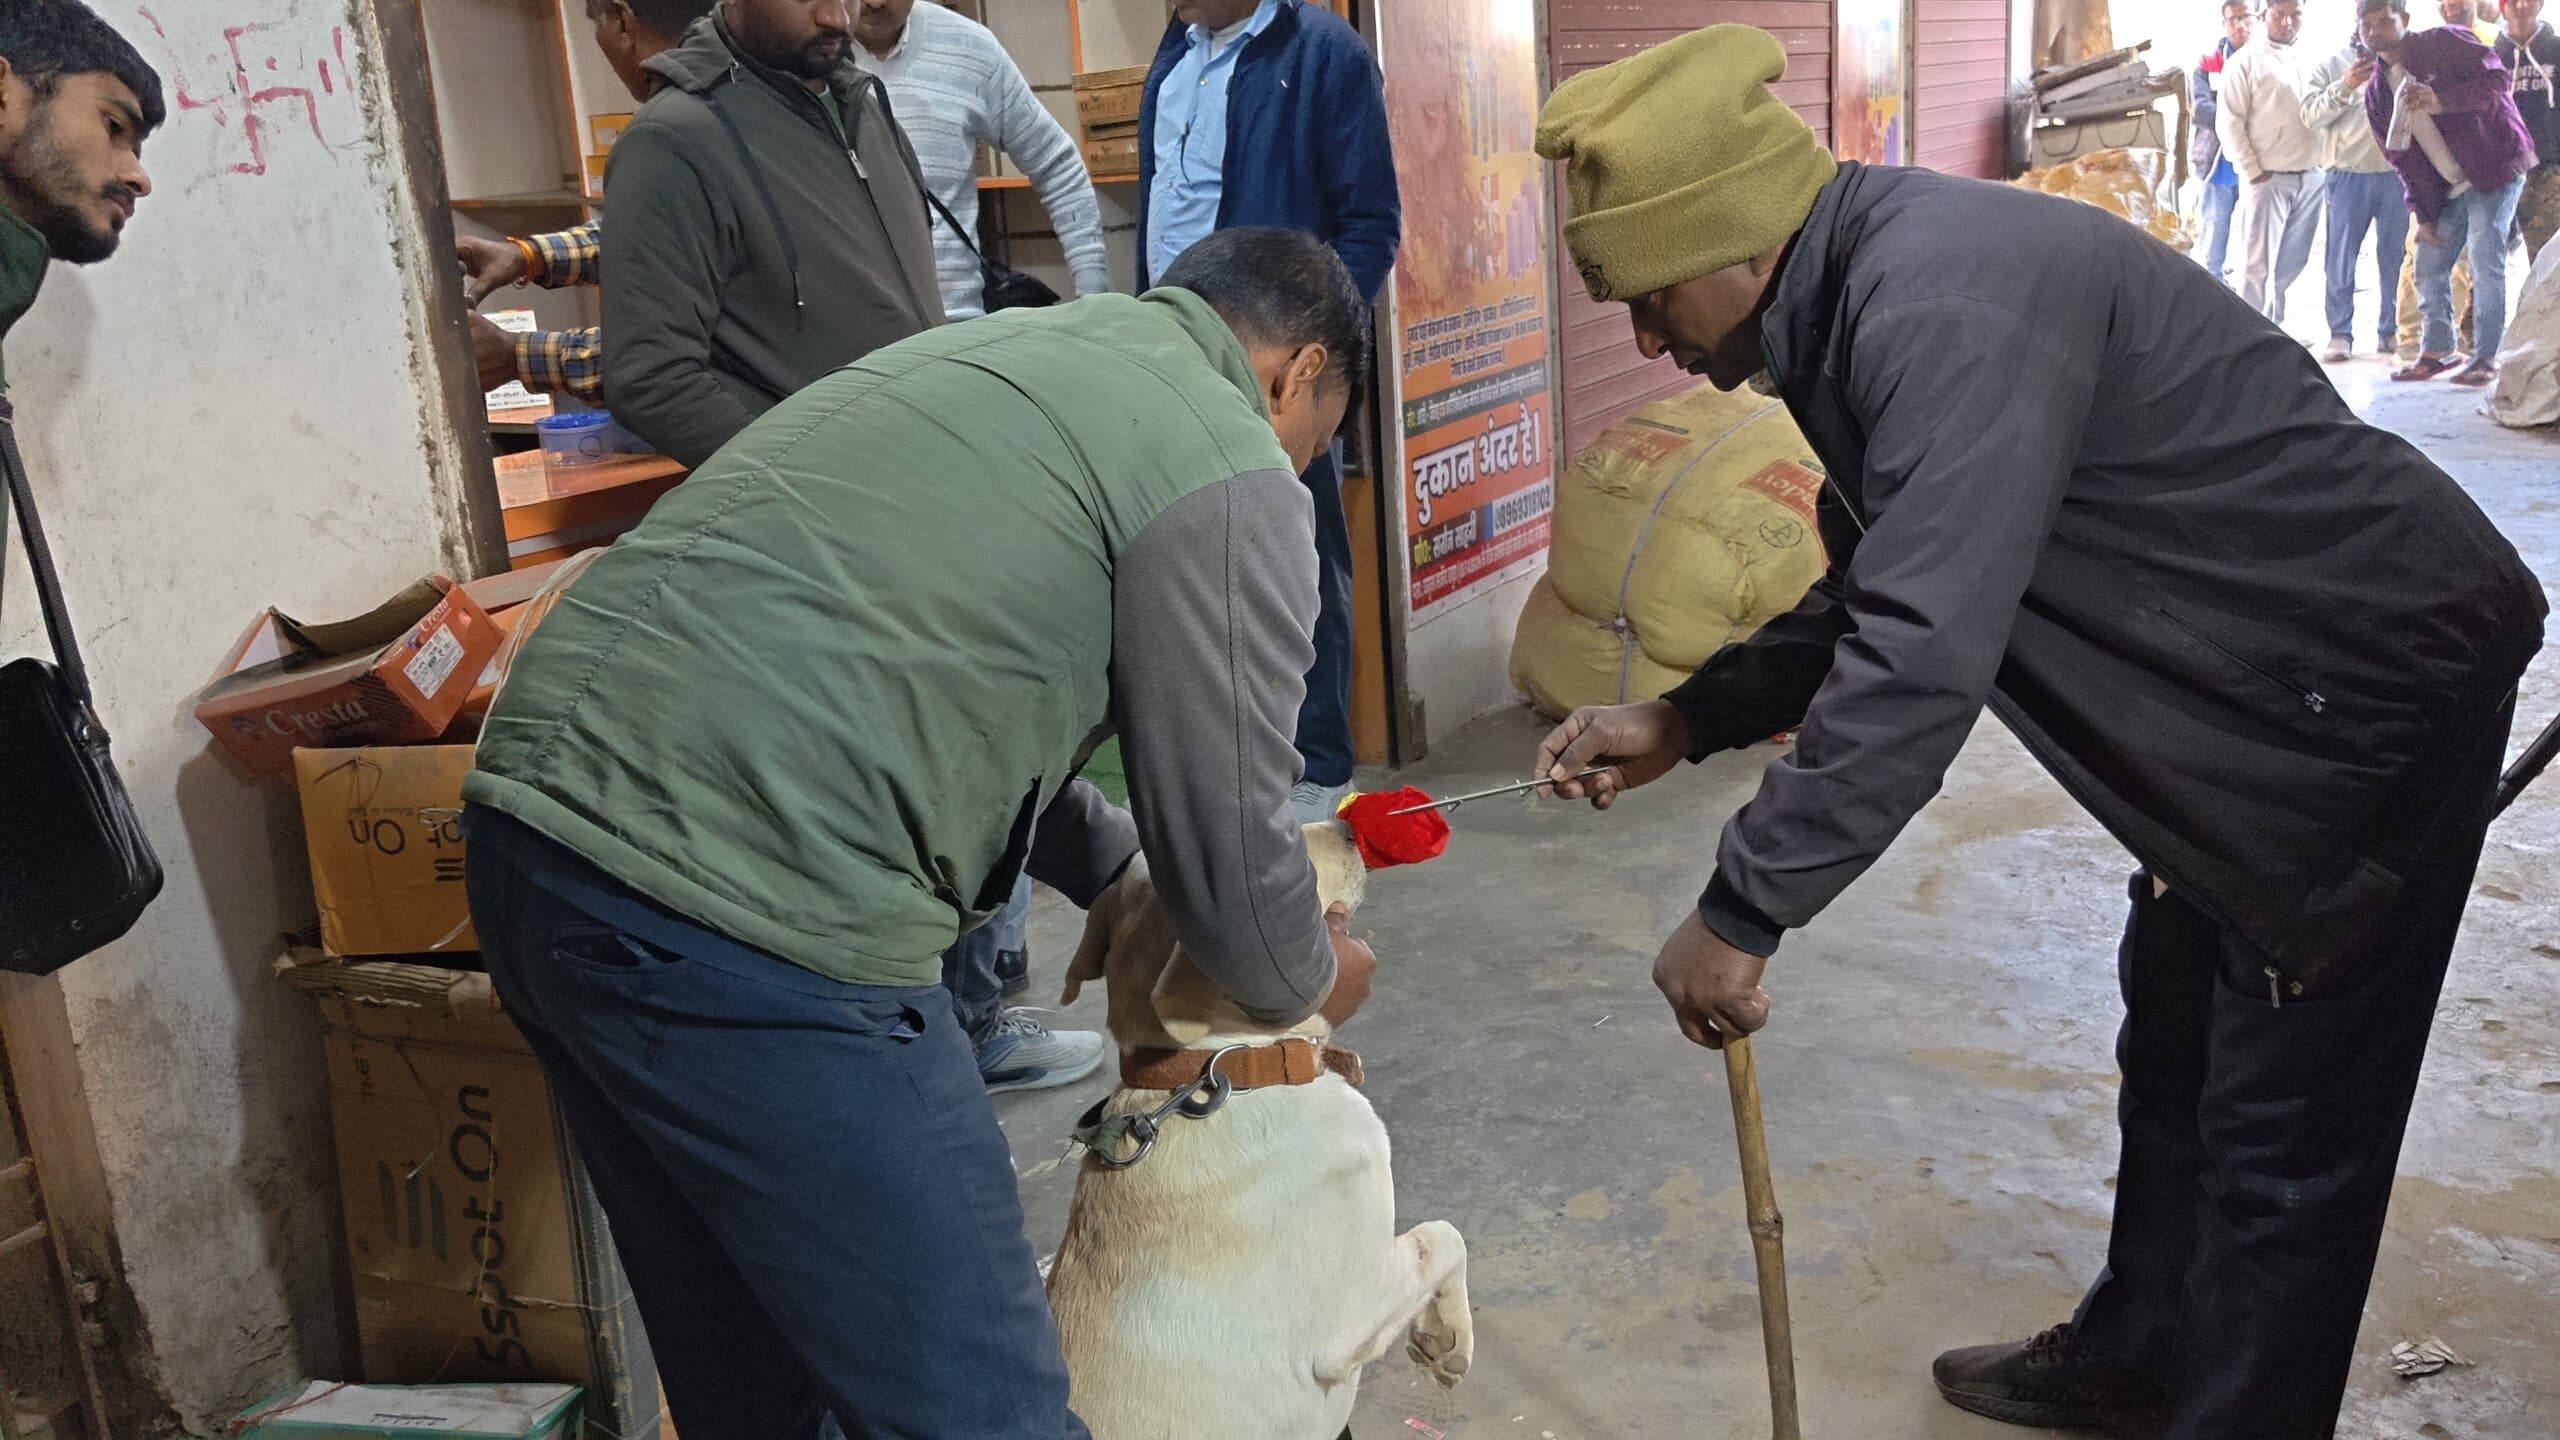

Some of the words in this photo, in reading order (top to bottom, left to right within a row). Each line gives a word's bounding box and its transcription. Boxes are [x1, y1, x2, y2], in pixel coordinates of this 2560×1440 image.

[1413, 439, 1476, 525] दुकान
[1479, 413, 1519, 475] अंदर
[265, 698, 369, 736] Cresta
[348, 818, 406, 855] On
[450, 1083, 499, 1184] On
